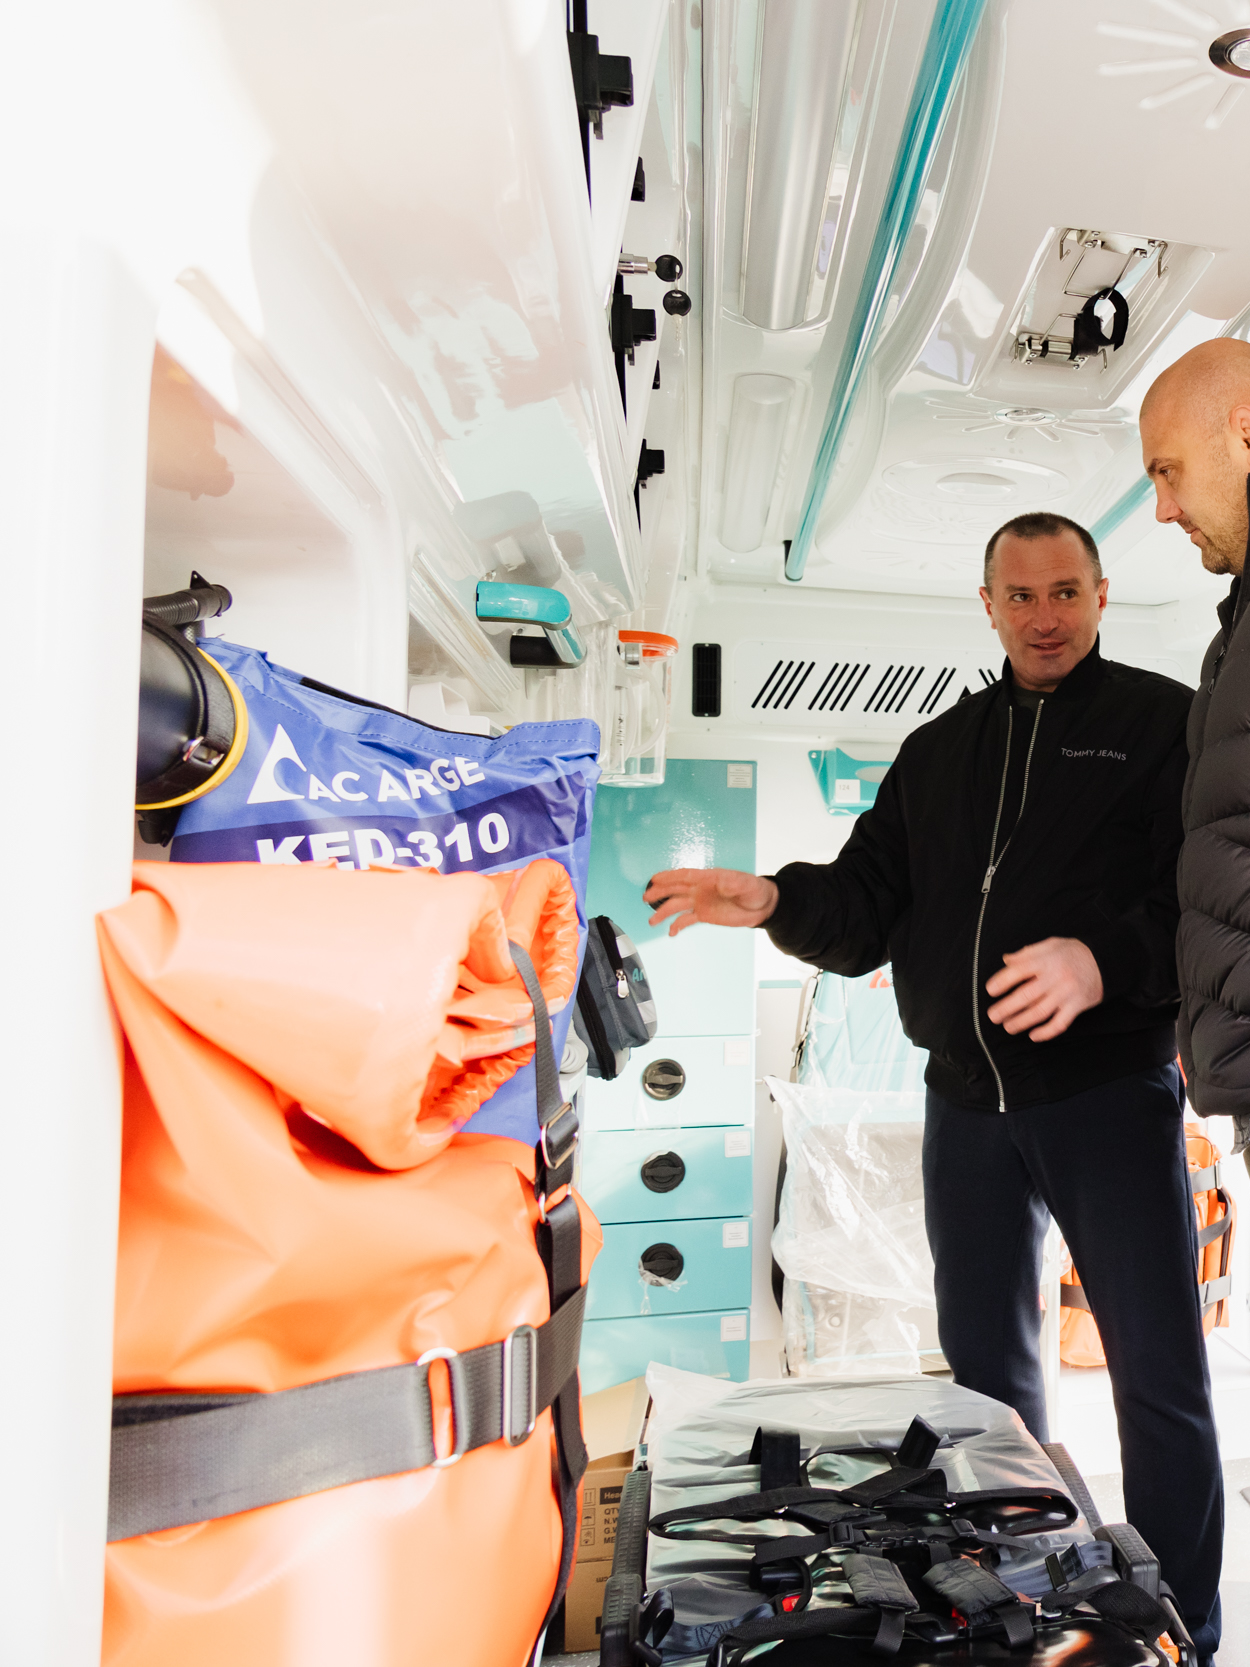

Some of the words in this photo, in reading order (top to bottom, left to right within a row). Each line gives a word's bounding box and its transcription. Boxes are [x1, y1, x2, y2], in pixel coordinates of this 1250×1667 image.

[1061, 747, 1095, 758] TOMMY
[1096, 749, 1127, 761] JEANS
[308, 770, 369, 803] AC
[377, 756, 486, 802] ARGE
[256, 812, 510, 873] KED-310
